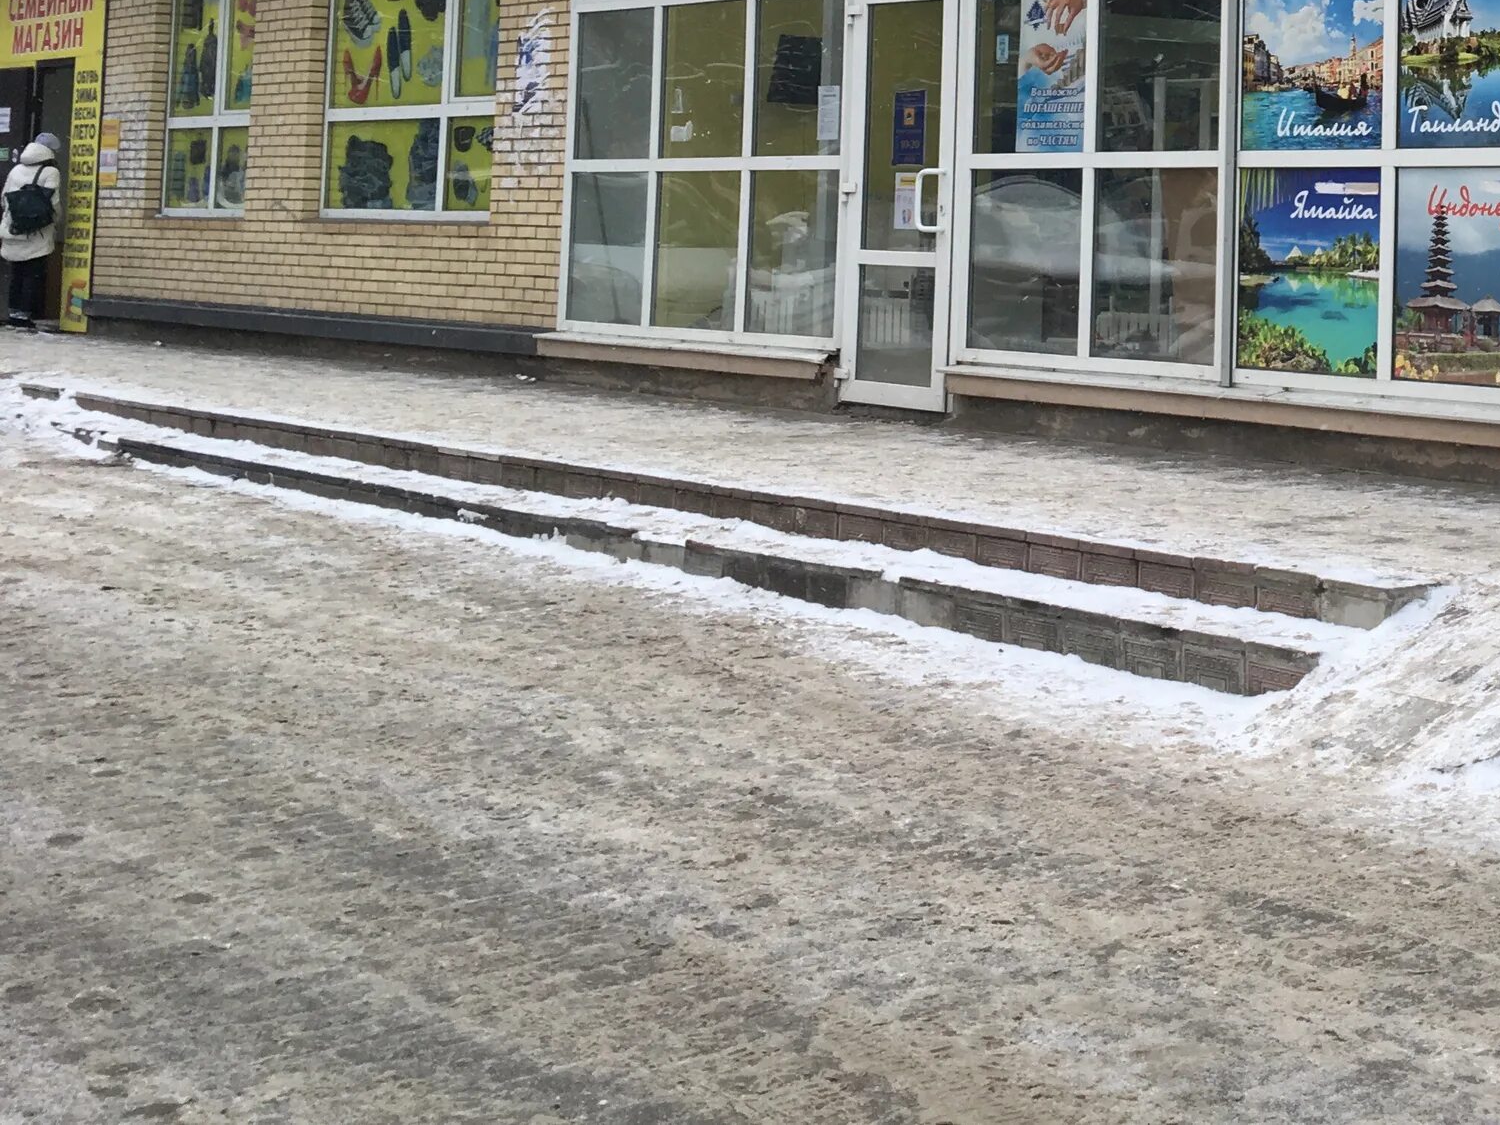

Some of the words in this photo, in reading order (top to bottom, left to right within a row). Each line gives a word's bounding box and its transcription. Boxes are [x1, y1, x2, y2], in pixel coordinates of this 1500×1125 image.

[12, 17, 84, 55] МАГАЗИН
[1030, 87, 1078, 97] Возможно
[1023, 102, 1085, 113] ПОГАШЕНИЕ
[1277, 106, 1373, 139] Италия
[1040, 135, 1077, 145] ЧАСТЯМ
[1290, 190, 1378, 221] Ямайка
